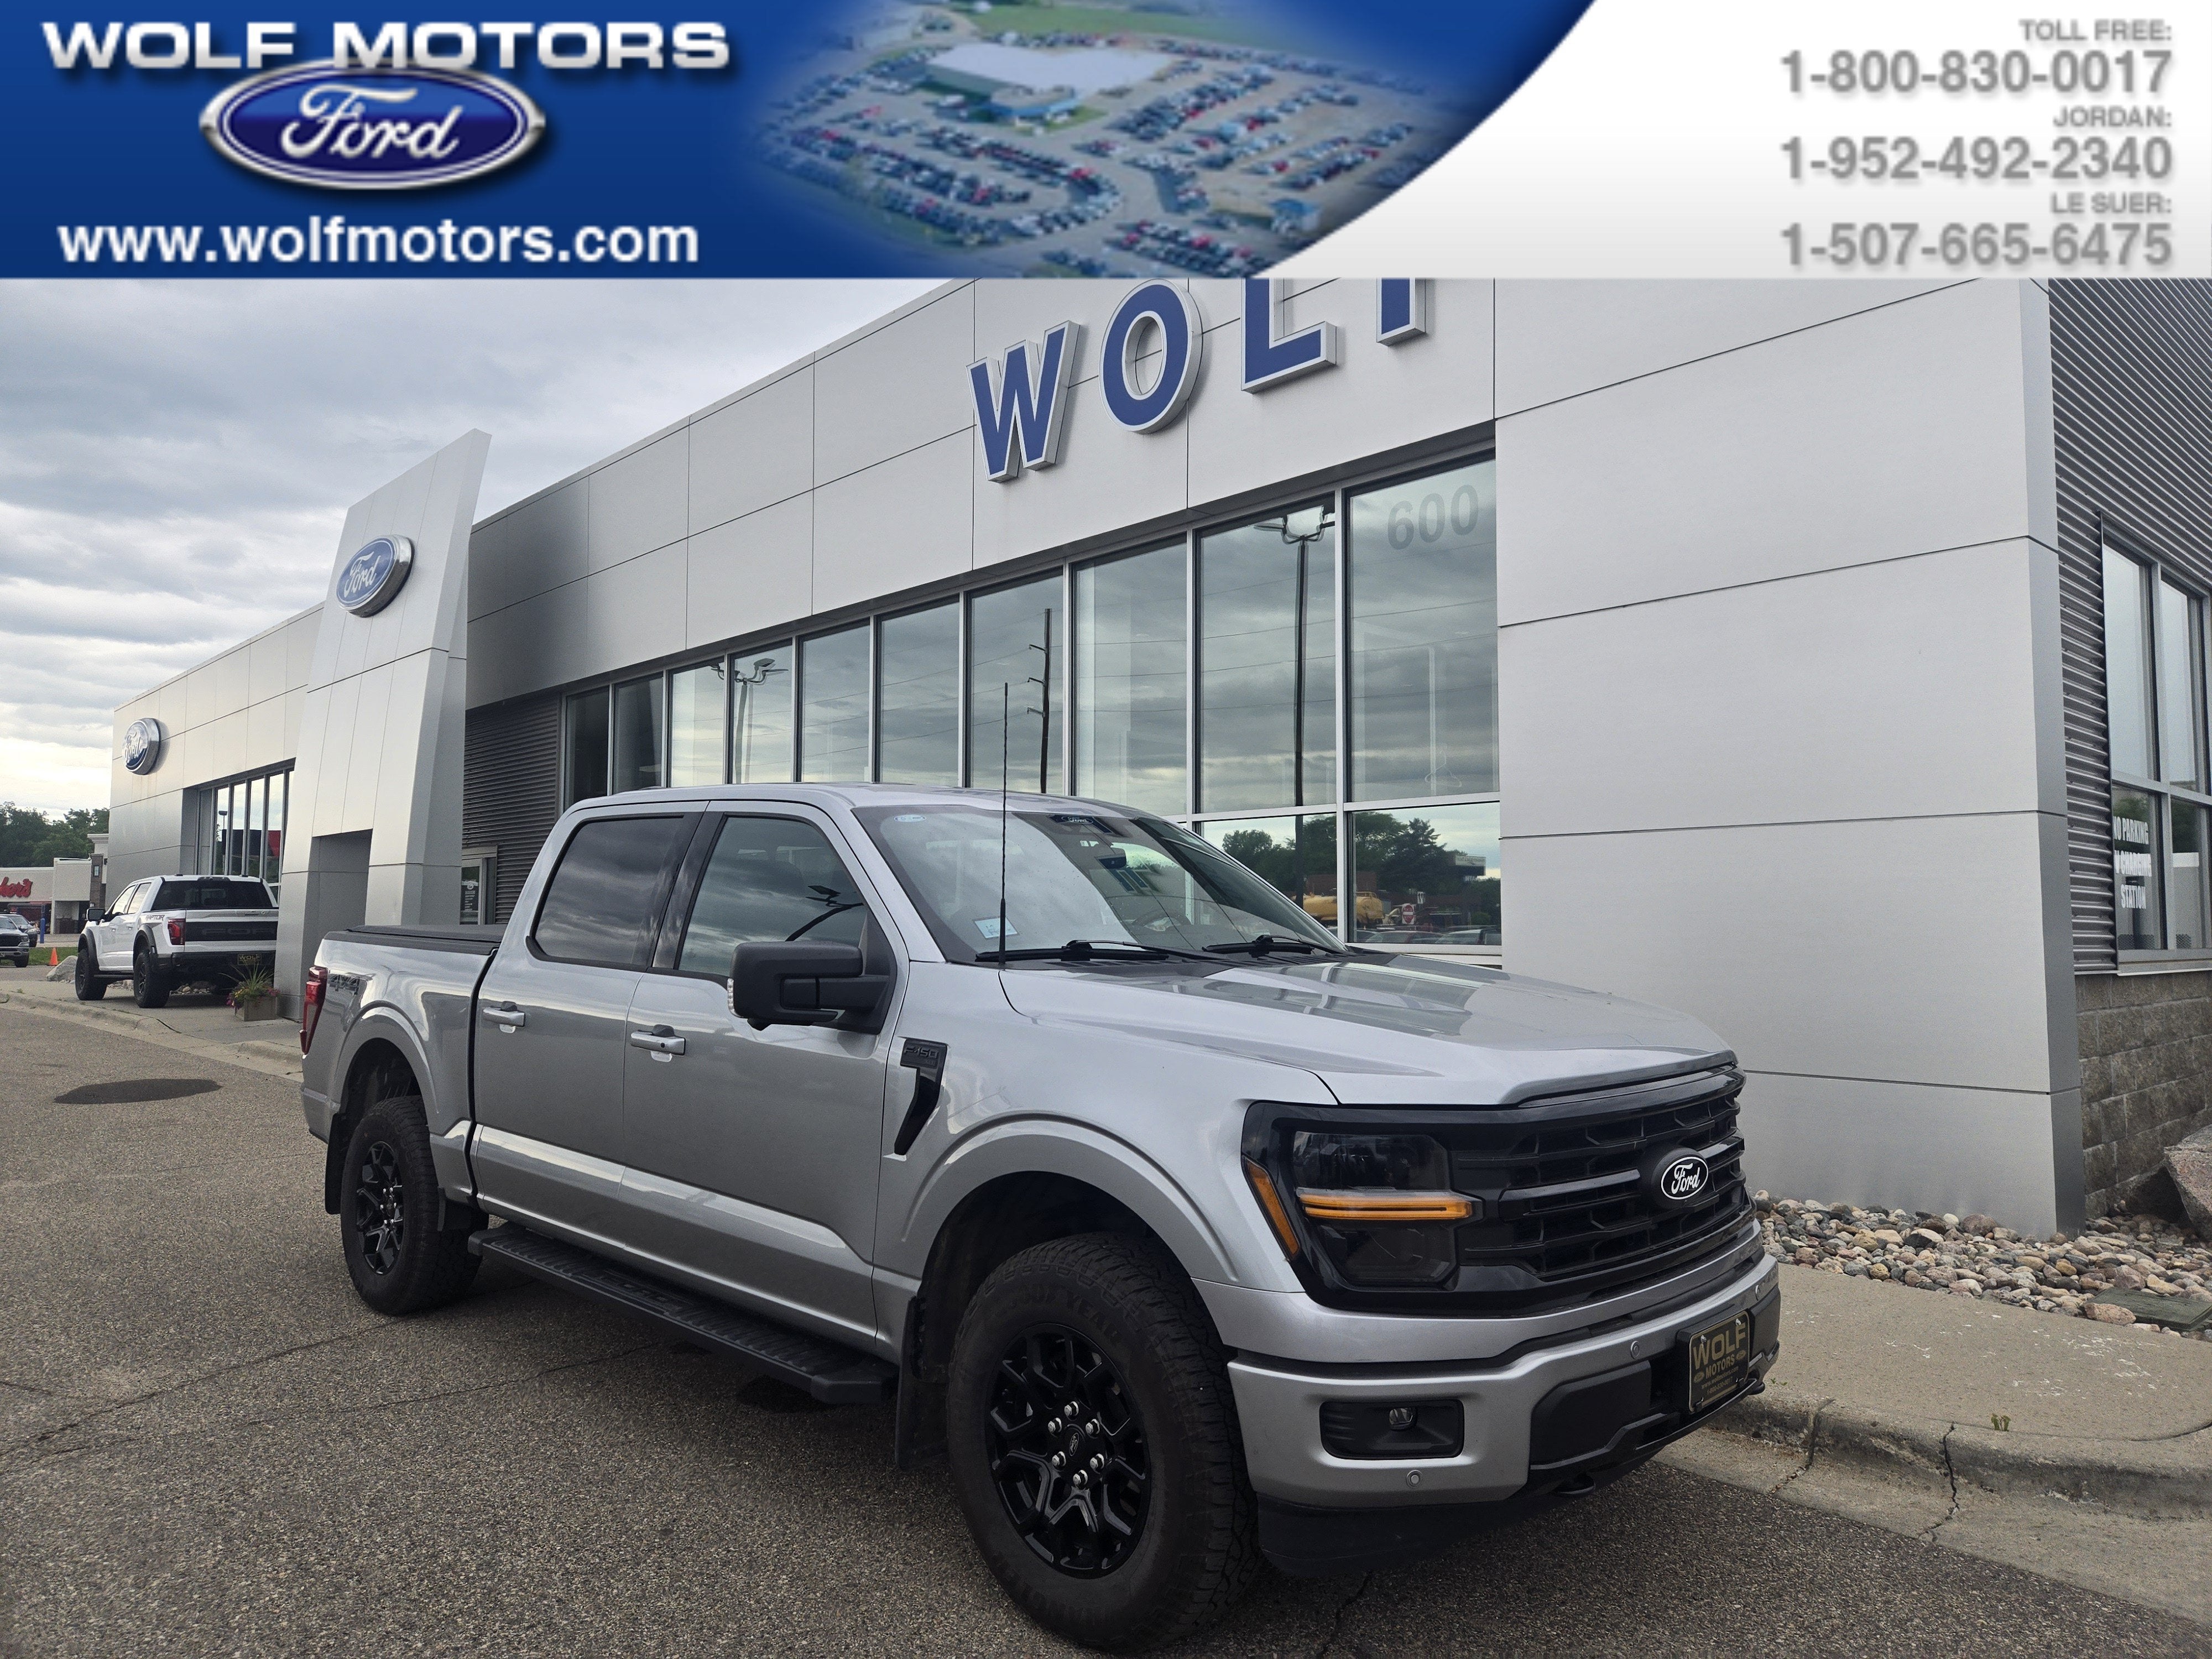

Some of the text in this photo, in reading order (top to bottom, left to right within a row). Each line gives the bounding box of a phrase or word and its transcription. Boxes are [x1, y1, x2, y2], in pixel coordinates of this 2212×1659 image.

[1387, 483, 1479, 550] 600
[343, 551, 382, 598] Ford
[2113, 816, 2149, 845] NO PARKING
[2120, 850, 2152, 877] CHARGING
[2121, 884, 2147, 909] STATION
[1671, 1162, 1700, 1194] Ford
[1693, 1322, 1746, 1370] WOLF
[1705, 1354, 1735, 1379] MOTORS
